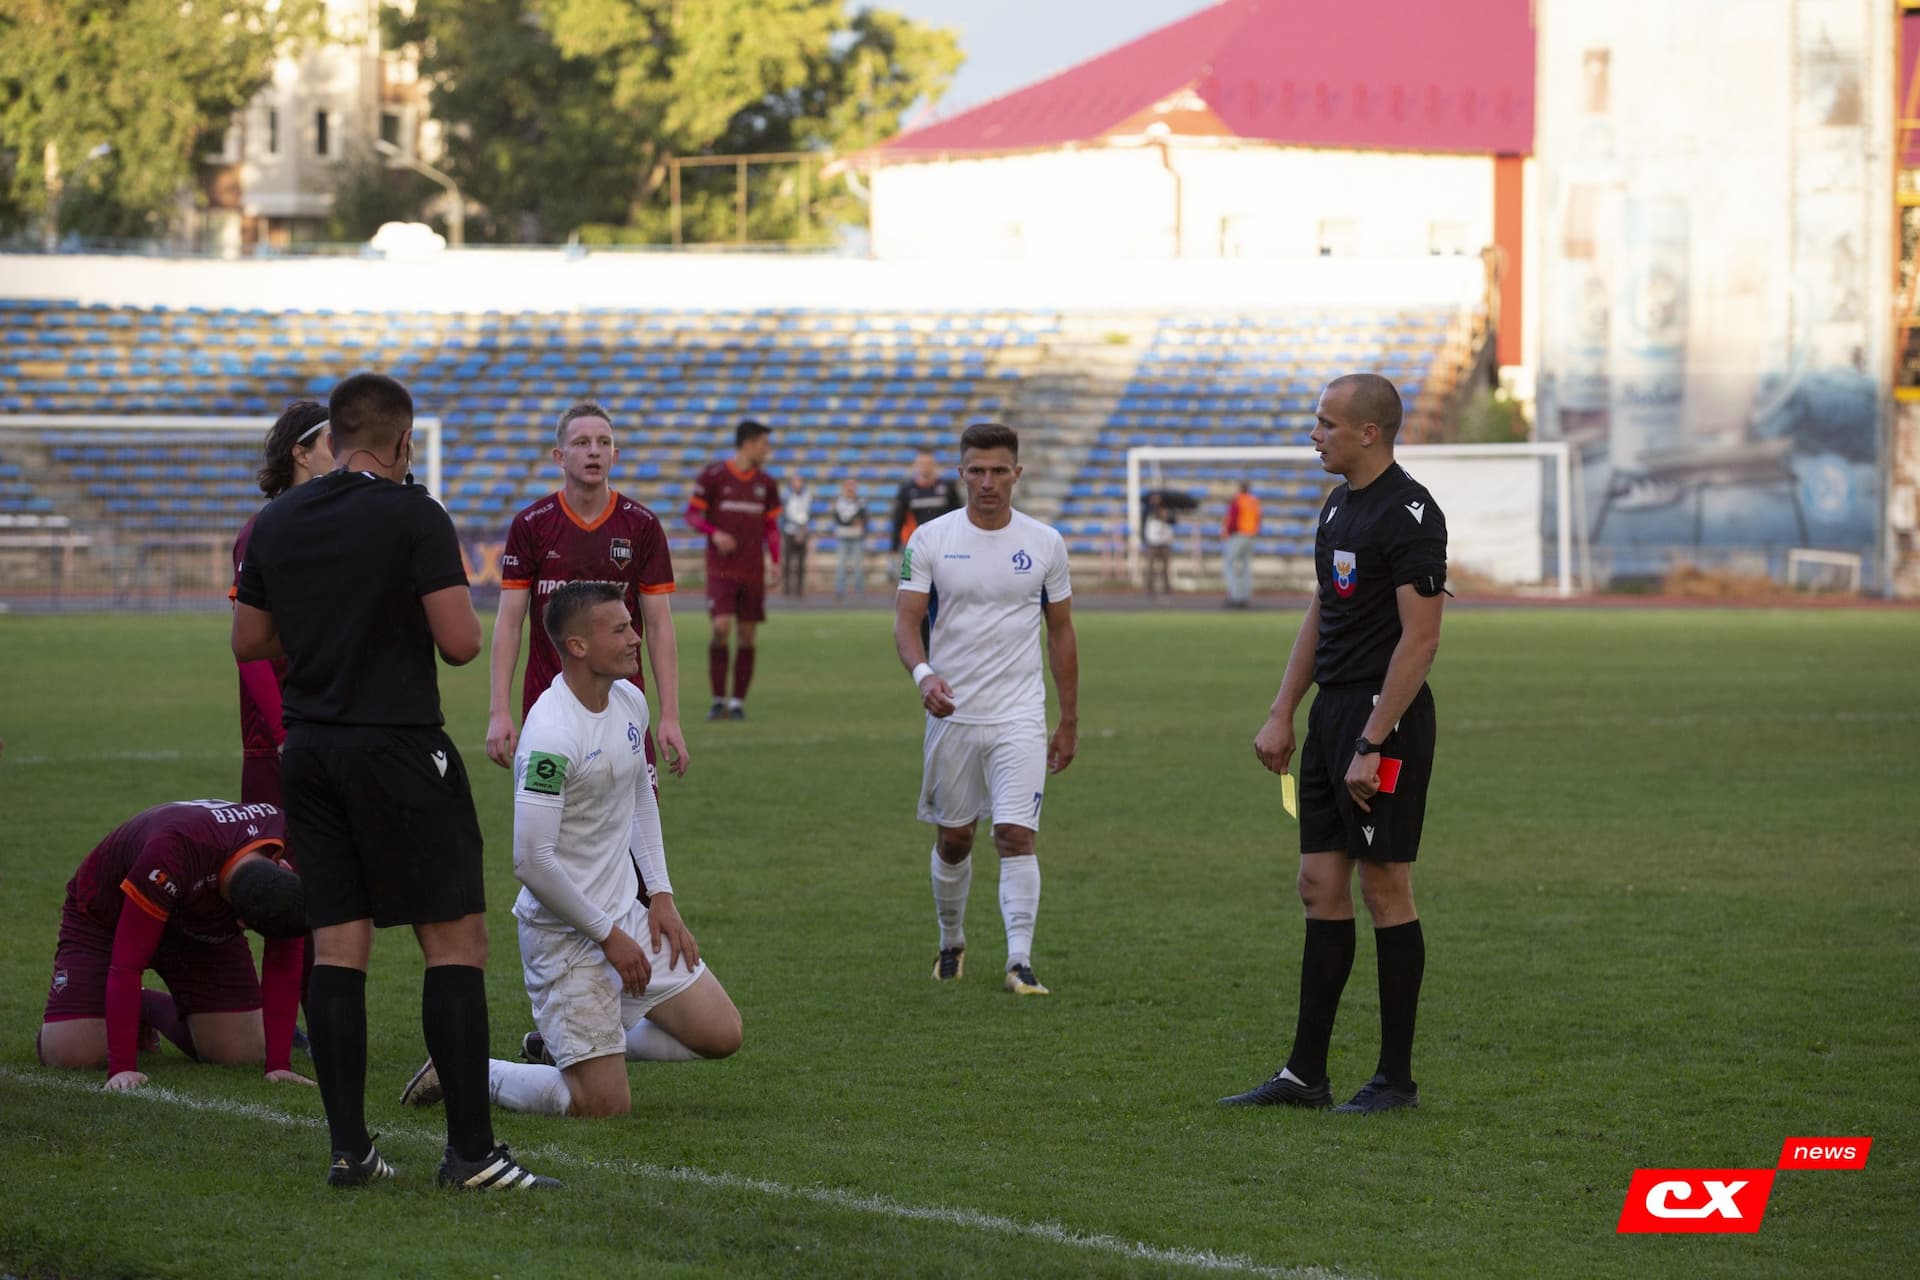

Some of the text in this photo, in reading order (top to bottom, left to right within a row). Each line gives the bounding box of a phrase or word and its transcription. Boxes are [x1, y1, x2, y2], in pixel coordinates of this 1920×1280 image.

[538, 763, 553, 775] 2
[211, 803, 278, 824] СЫЧЕВ
[1033, 791, 1042, 817] 7
